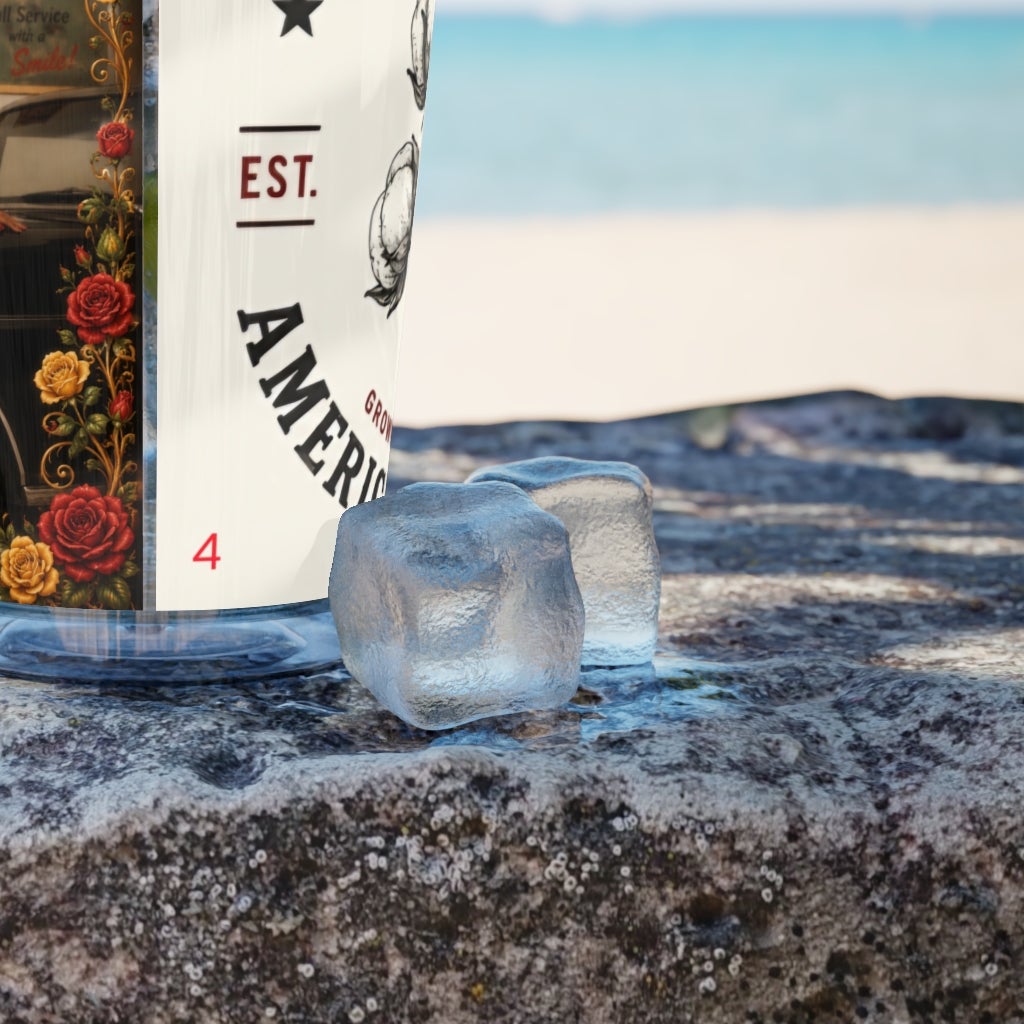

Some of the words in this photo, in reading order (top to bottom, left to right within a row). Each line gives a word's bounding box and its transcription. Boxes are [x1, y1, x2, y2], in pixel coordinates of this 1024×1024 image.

[17, 5, 71, 24] Service
[240, 155, 317, 199] EST.
[192, 532, 221, 570] 4
